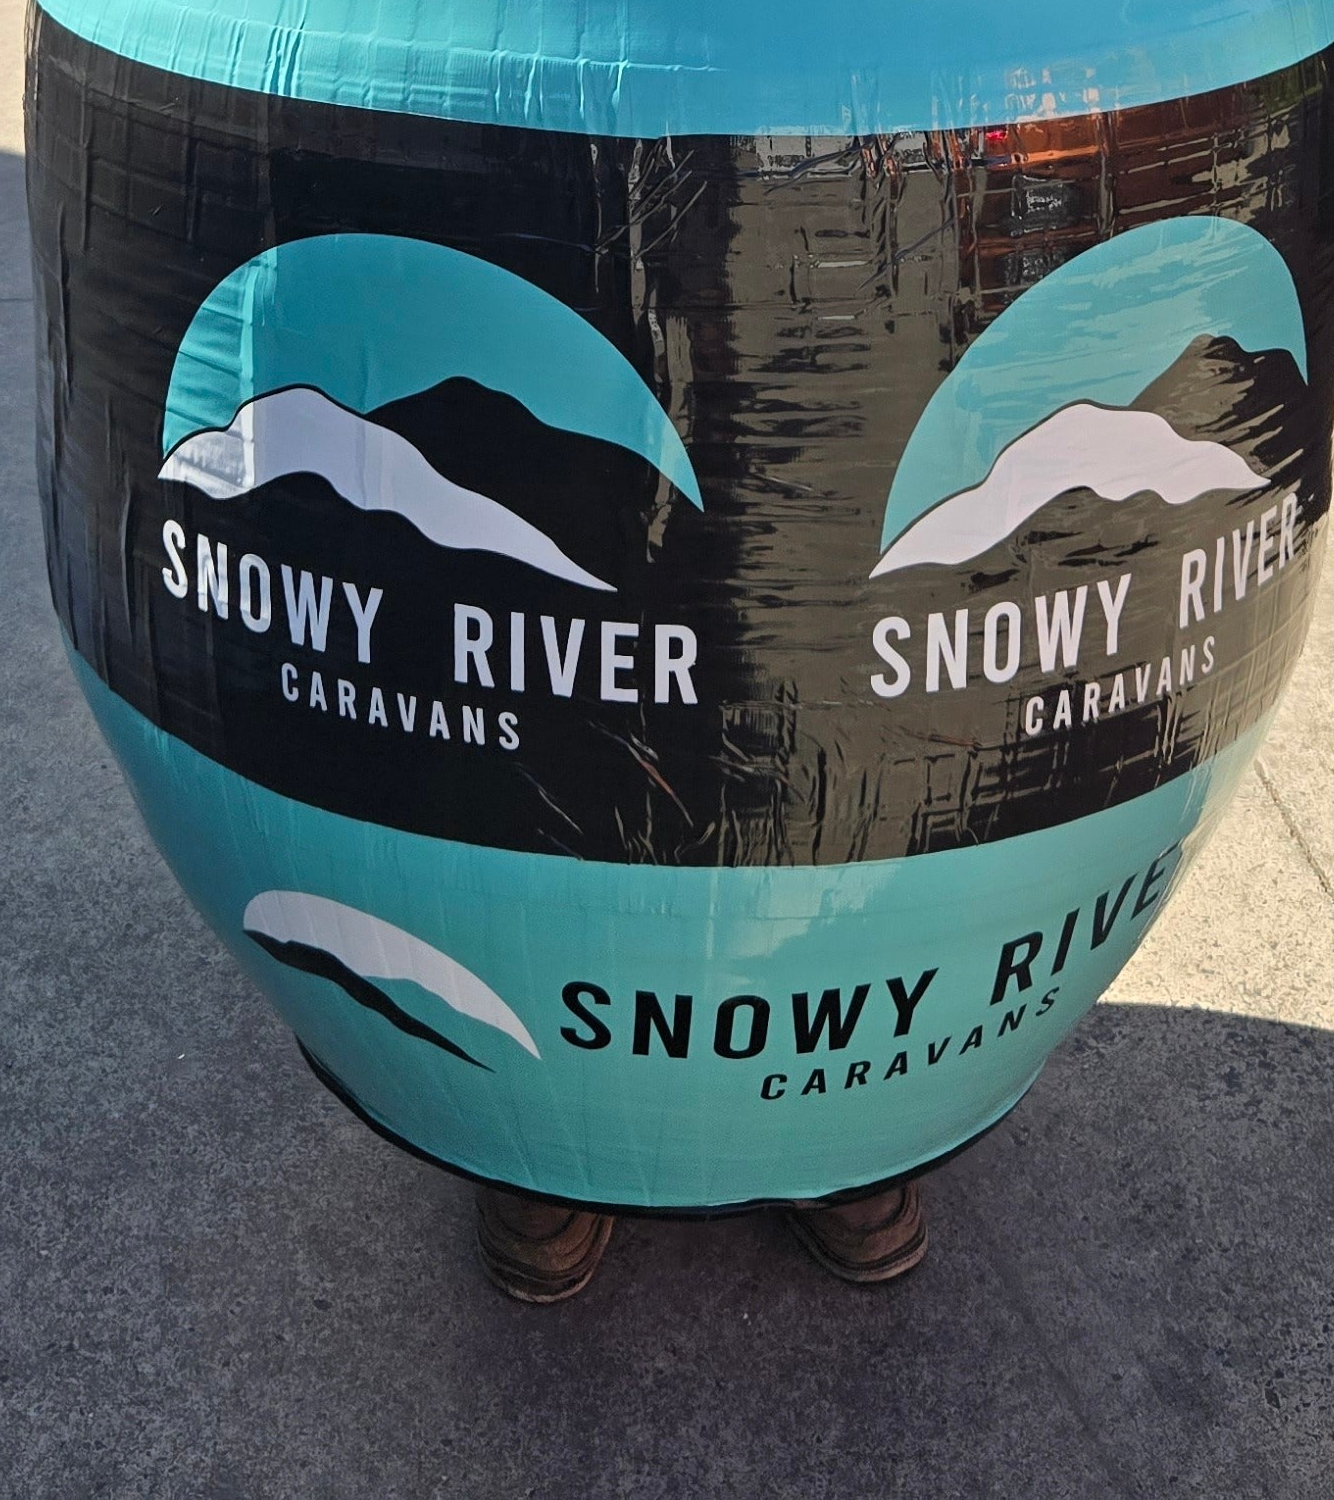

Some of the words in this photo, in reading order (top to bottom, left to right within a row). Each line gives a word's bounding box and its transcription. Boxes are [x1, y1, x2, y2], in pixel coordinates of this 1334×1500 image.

[161, 519, 384, 664] SNOWY
[454, 603, 698, 706] RIVER
[870, 574, 1132, 698] SNOWY
[1179, 492, 1301, 629] RIVER
[281, 662, 521, 750] CARAVANS
[1025, 636, 1215, 735] CARAVANS
[560, 967, 939, 1060] SNOWY
[760, 987, 1060, 1100] CARAVANS
